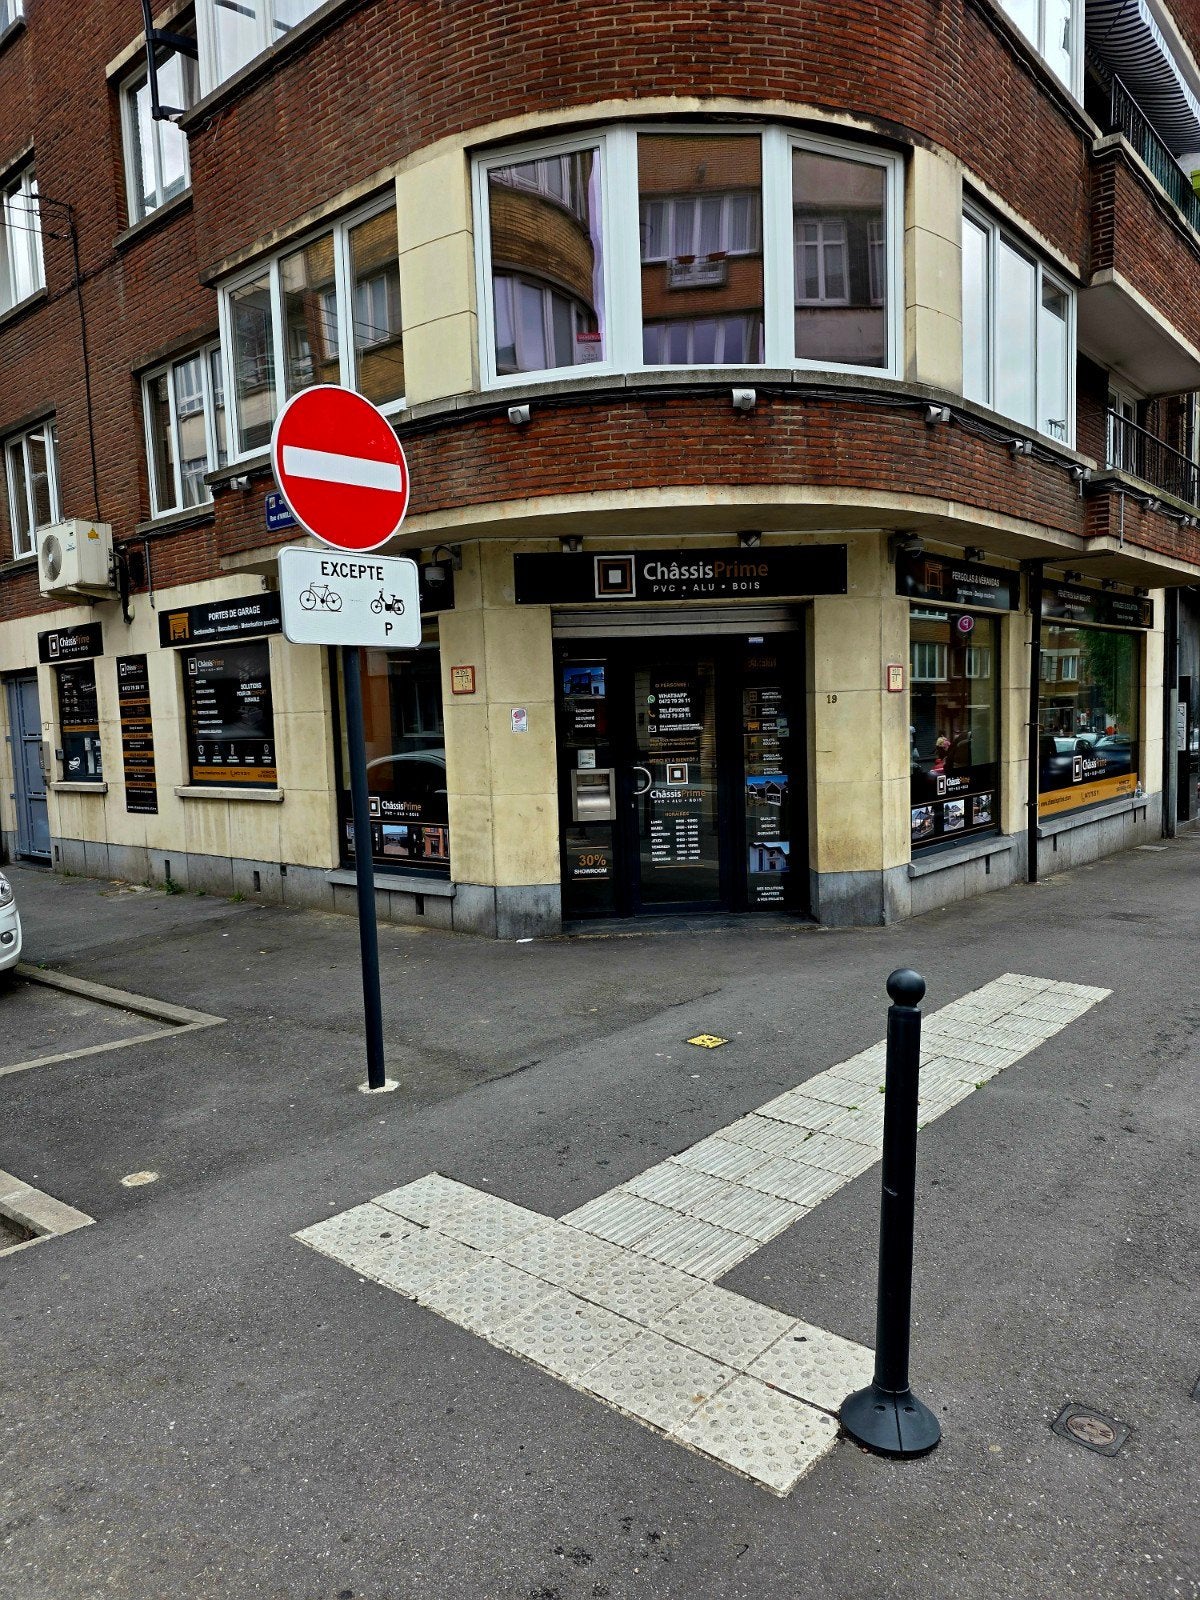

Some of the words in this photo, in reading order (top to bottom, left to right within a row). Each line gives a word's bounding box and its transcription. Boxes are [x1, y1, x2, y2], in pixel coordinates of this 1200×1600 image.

[321, 561, 384, 581] EXCEPTE
[643, 561, 768, 580] ChâssisPrime
[653, 584, 676, 593] PVC
[693, 583, 715, 591] ALU
[732, 581, 761, 590] BOIS
[208, 611, 229, 621] PORTES
[230, 609, 237, 618] DE
[237, 605, 261, 616] GARAGE
[385, 622, 393, 636] P
[60, 635, 90, 647] ChâssisPrime
[240, 682, 262, 690] SOLUTIONS
[826, 694, 837, 704] 19
[649, 789, 706, 799] ChâssisPrime
[381, 801, 422, 811] ChâssisPrime
[579, 854, 607, 866] 30%
[573, 867, 607, 875] SHOWROOM
